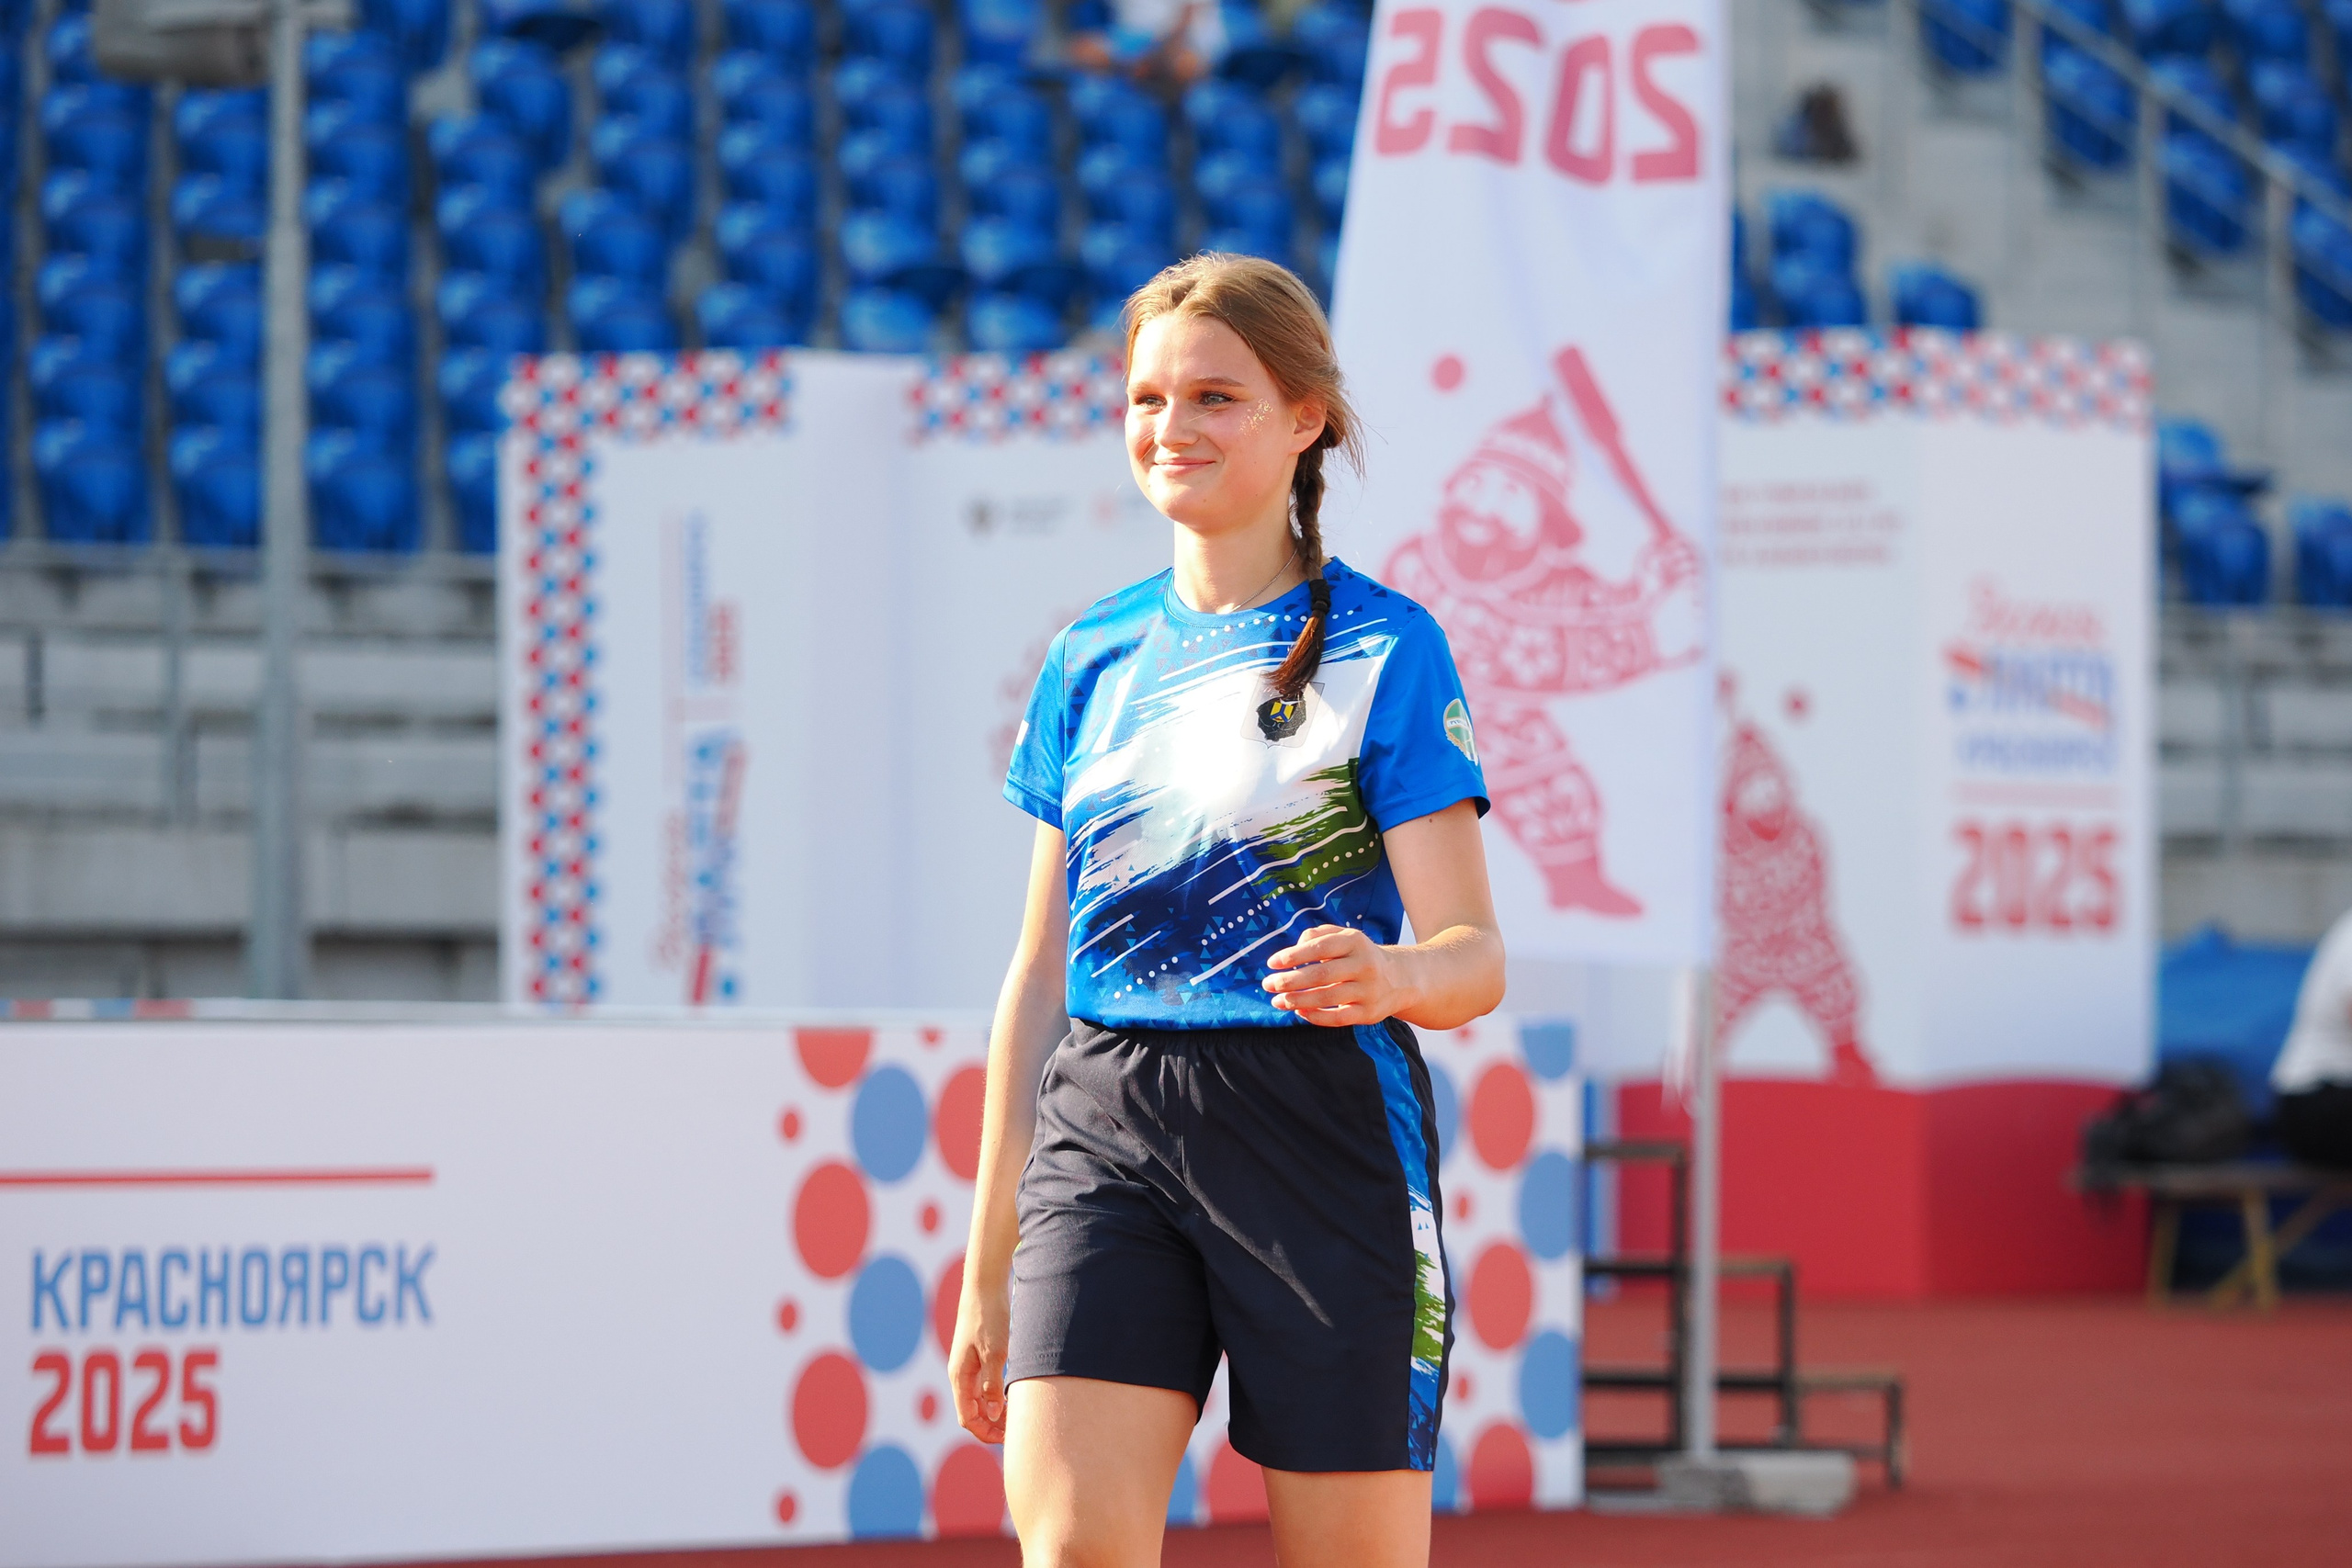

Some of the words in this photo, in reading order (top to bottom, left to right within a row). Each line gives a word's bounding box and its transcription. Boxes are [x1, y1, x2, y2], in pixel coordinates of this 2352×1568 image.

[1949, 820, 2121, 934] 2025
[30, 1243, 435, 1332] КРАСНОЯРСК
[28, 1347, 220, 1455] 2025
